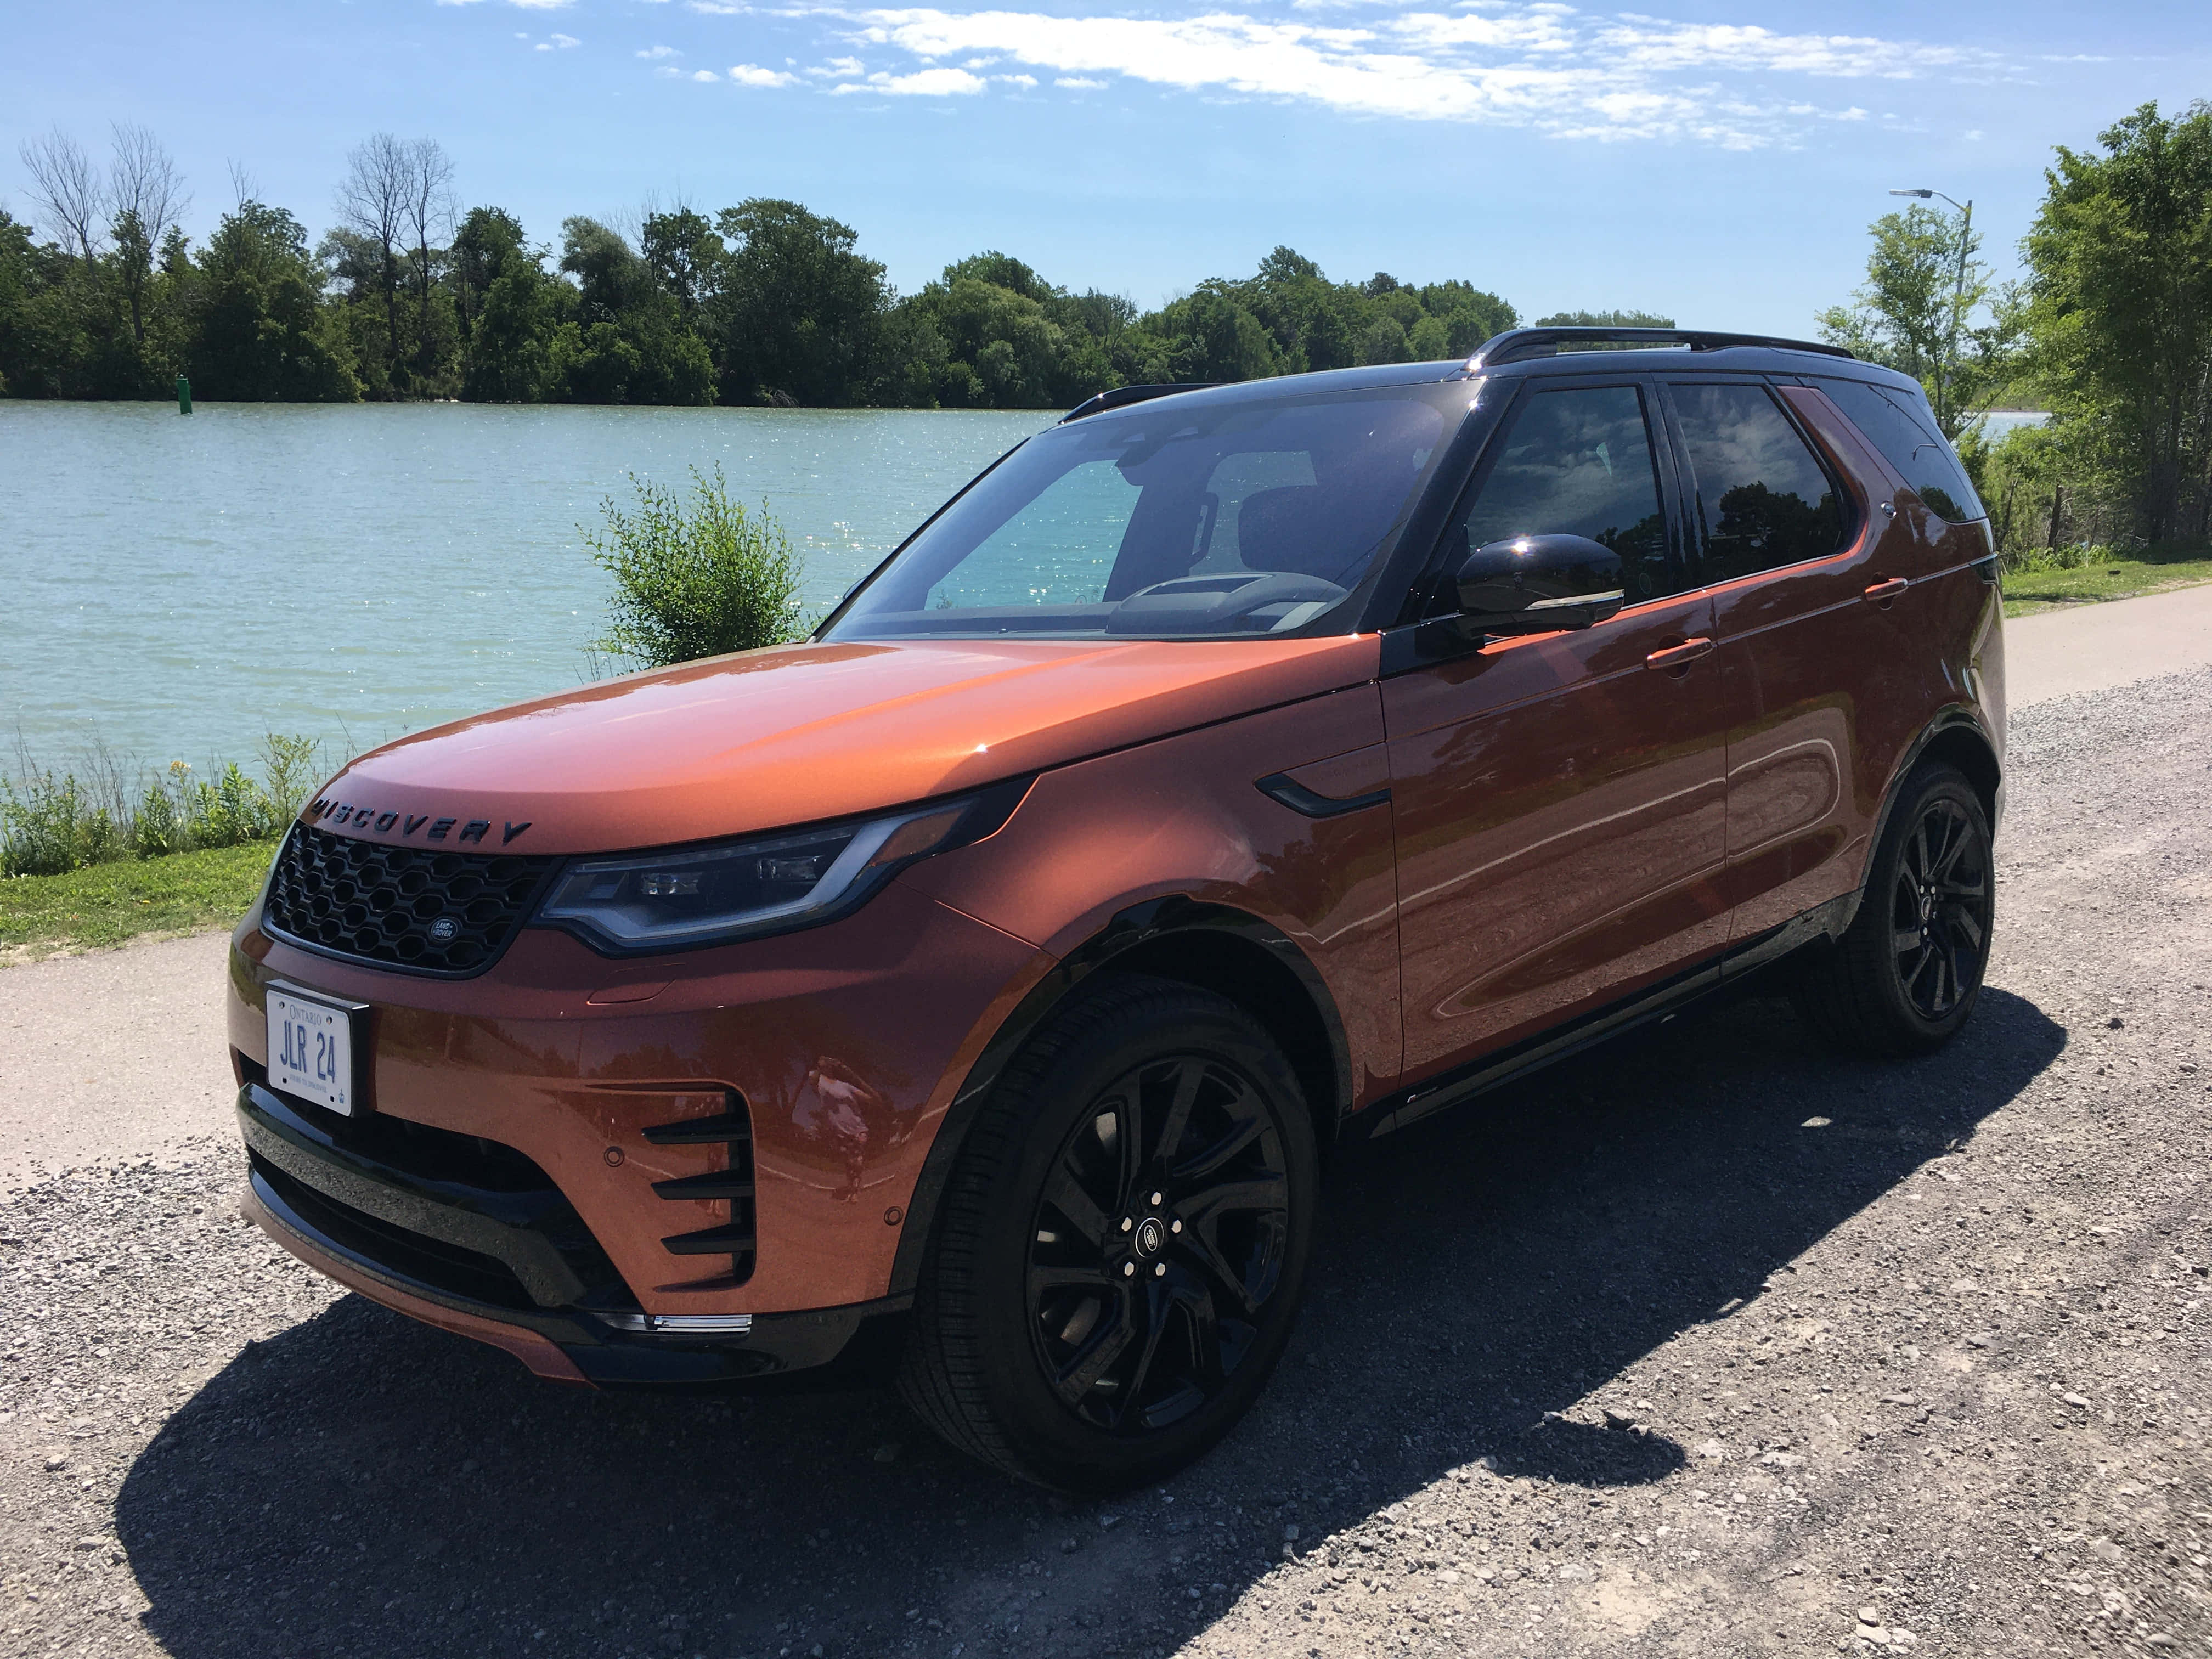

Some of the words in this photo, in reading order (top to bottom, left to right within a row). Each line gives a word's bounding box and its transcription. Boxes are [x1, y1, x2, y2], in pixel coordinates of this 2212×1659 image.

[311, 799, 532, 845] DISCOVERY
[289, 1005, 321, 1026] ONTARIO
[280, 1020, 307, 1073] JLR
[317, 1032, 335, 1084] 24
